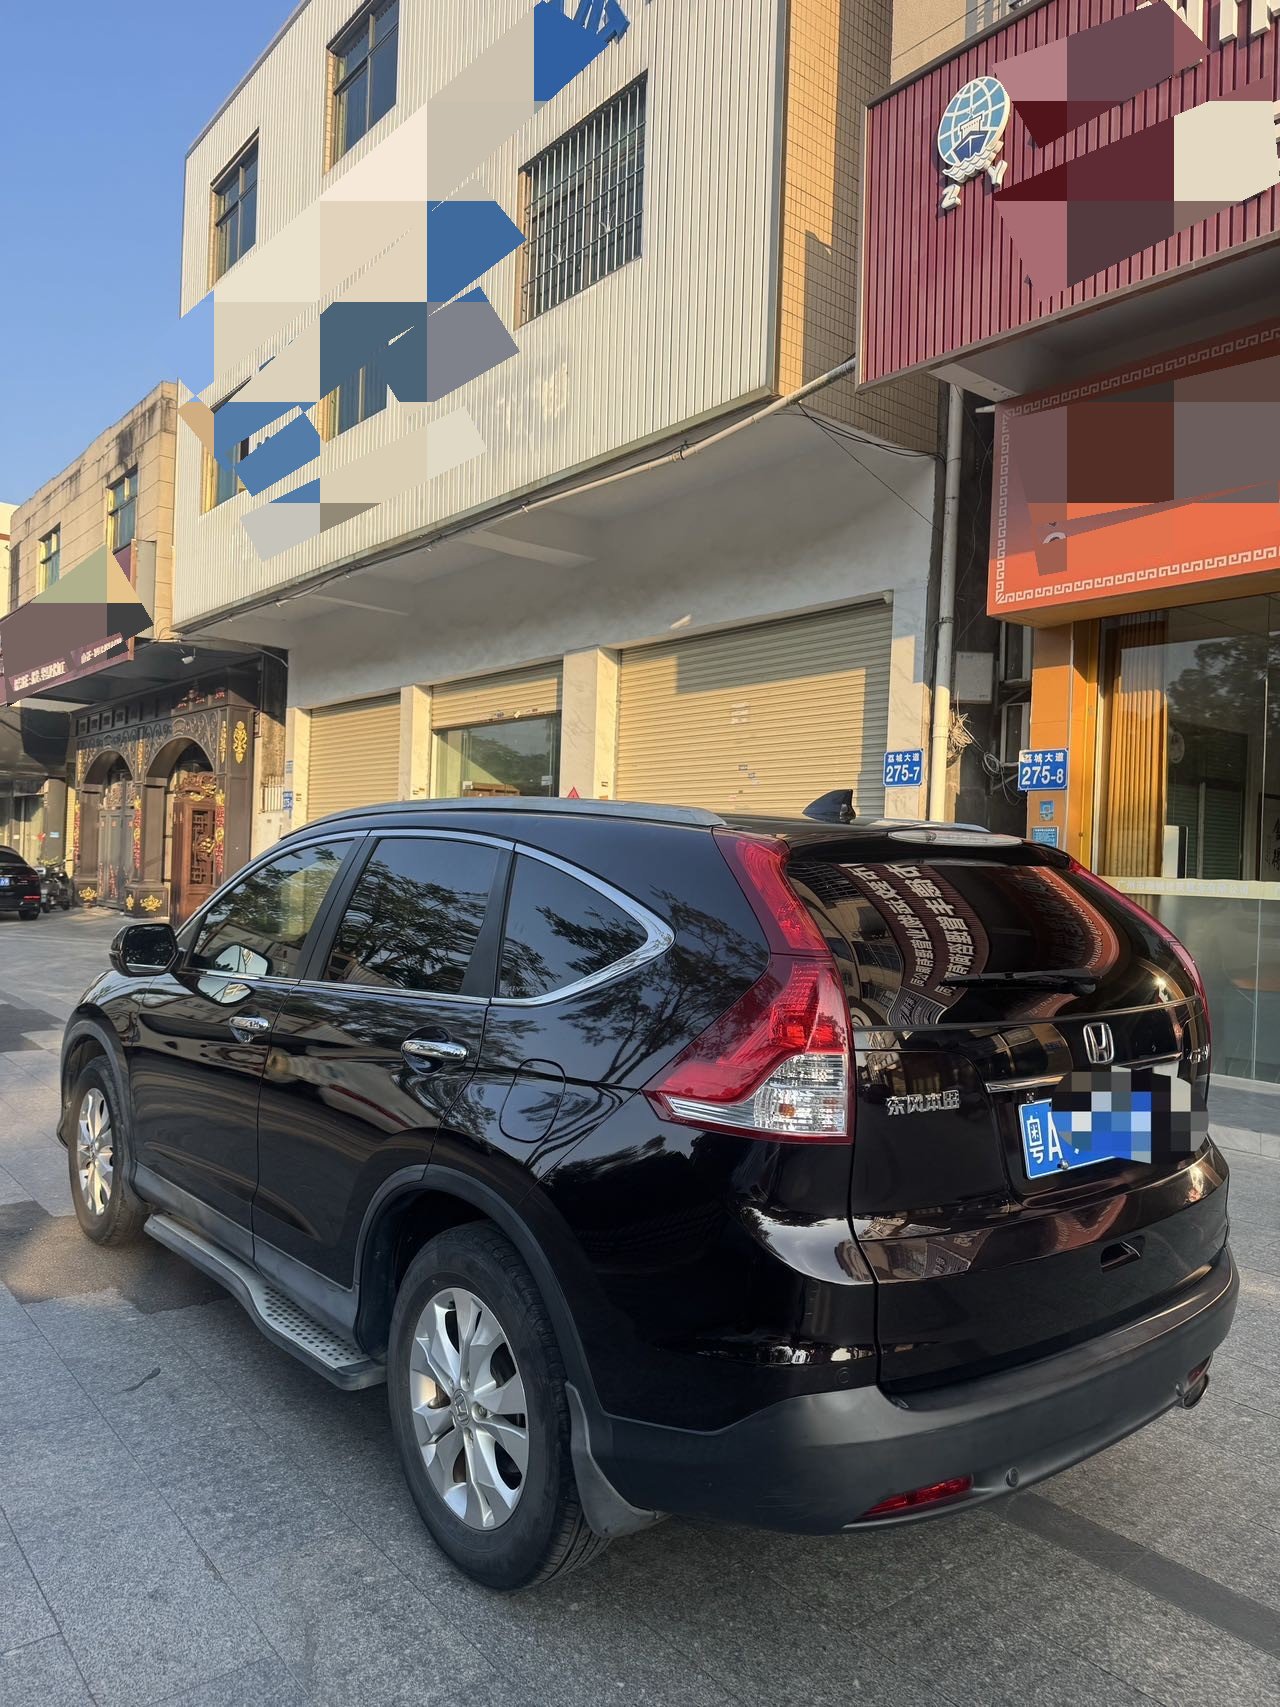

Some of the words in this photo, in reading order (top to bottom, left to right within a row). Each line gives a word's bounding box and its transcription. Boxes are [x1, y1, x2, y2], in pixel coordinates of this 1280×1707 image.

[886, 765, 920, 782] 275-7
[1021, 765, 1064, 785] 275-8
[886, 1089, 960, 1115] 东风本田
